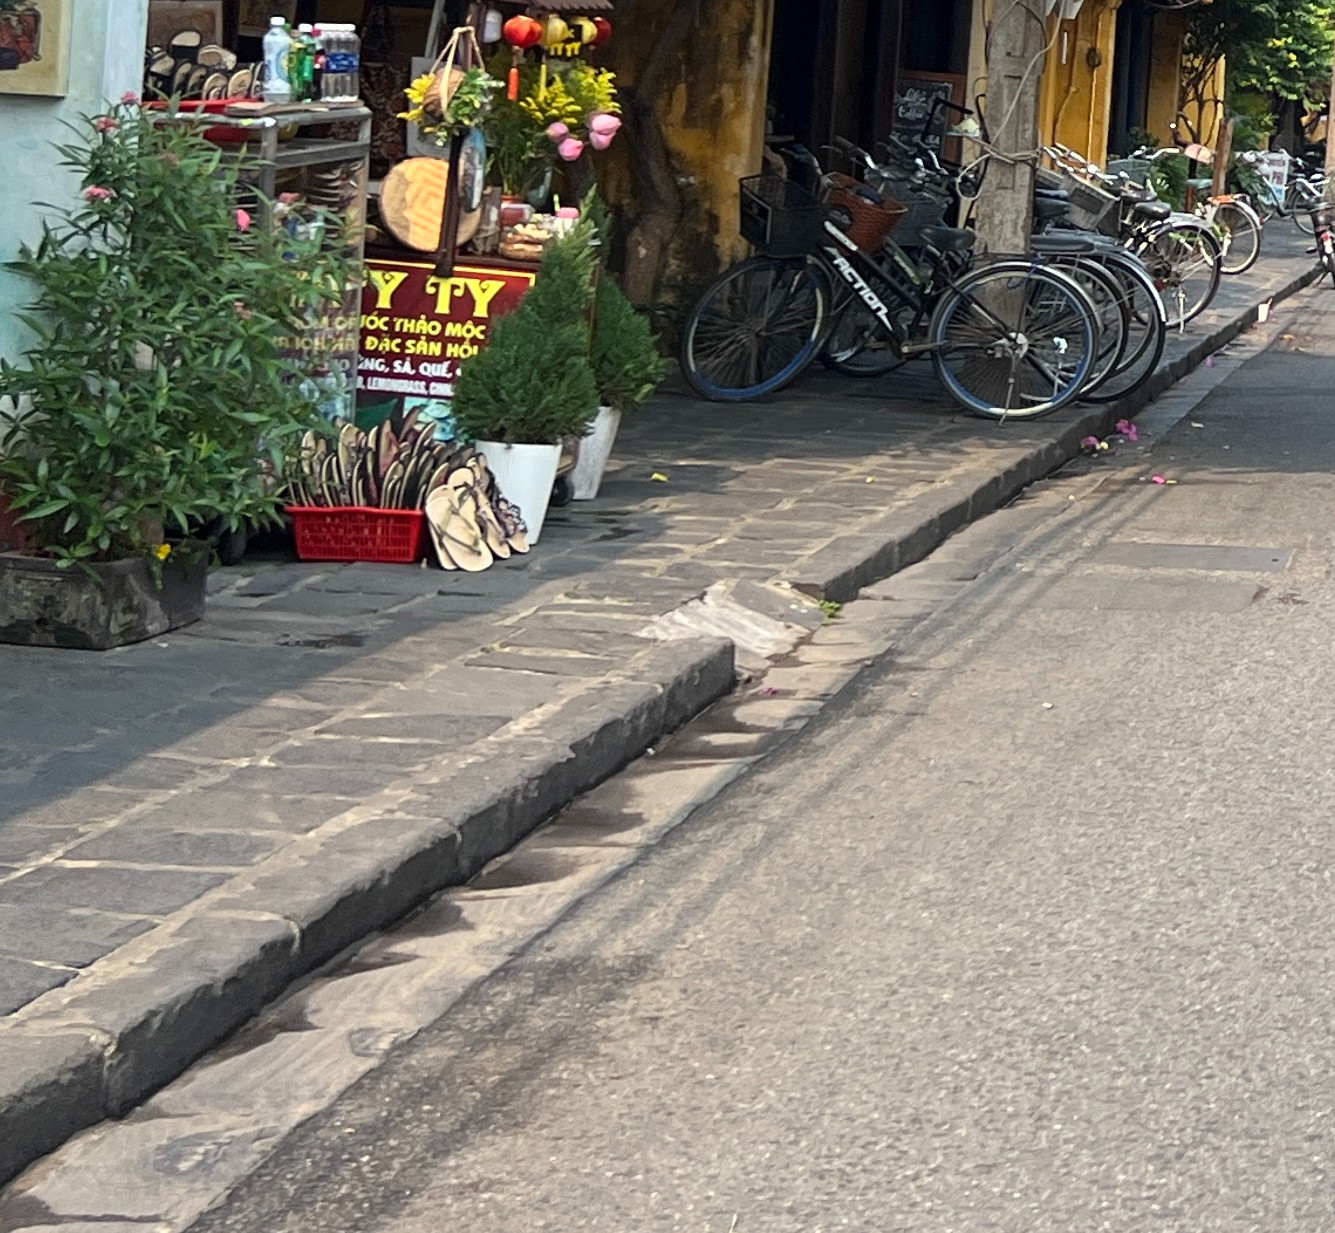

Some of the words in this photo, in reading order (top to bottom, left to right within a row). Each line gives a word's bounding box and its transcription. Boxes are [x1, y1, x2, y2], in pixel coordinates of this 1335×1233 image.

[425, 276, 506, 318] TY
[823, 246, 893, 331] ACTION
[393, 314, 442, 336] THẢO
[445, 320, 486, 340] MỘC
